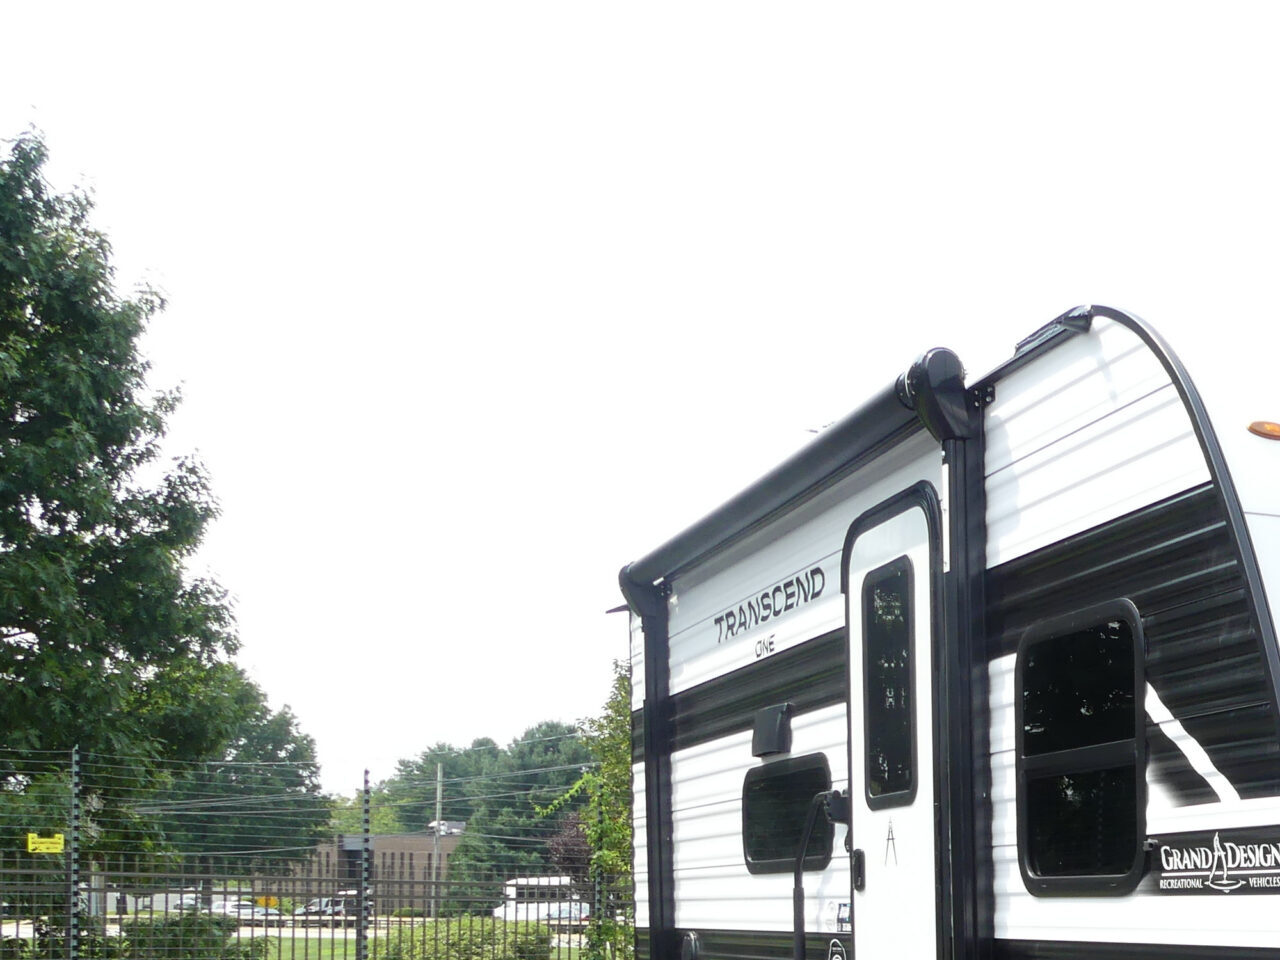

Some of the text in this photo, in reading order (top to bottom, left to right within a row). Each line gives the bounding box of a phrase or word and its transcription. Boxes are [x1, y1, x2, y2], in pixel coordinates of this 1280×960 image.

[714, 566, 825, 643] TRANSCEND
[755, 634, 775, 658] ONE
[1160, 845, 1213, 870] GRAND
[1160, 876, 1280, 889] RECREATIONAL VEHICLES
